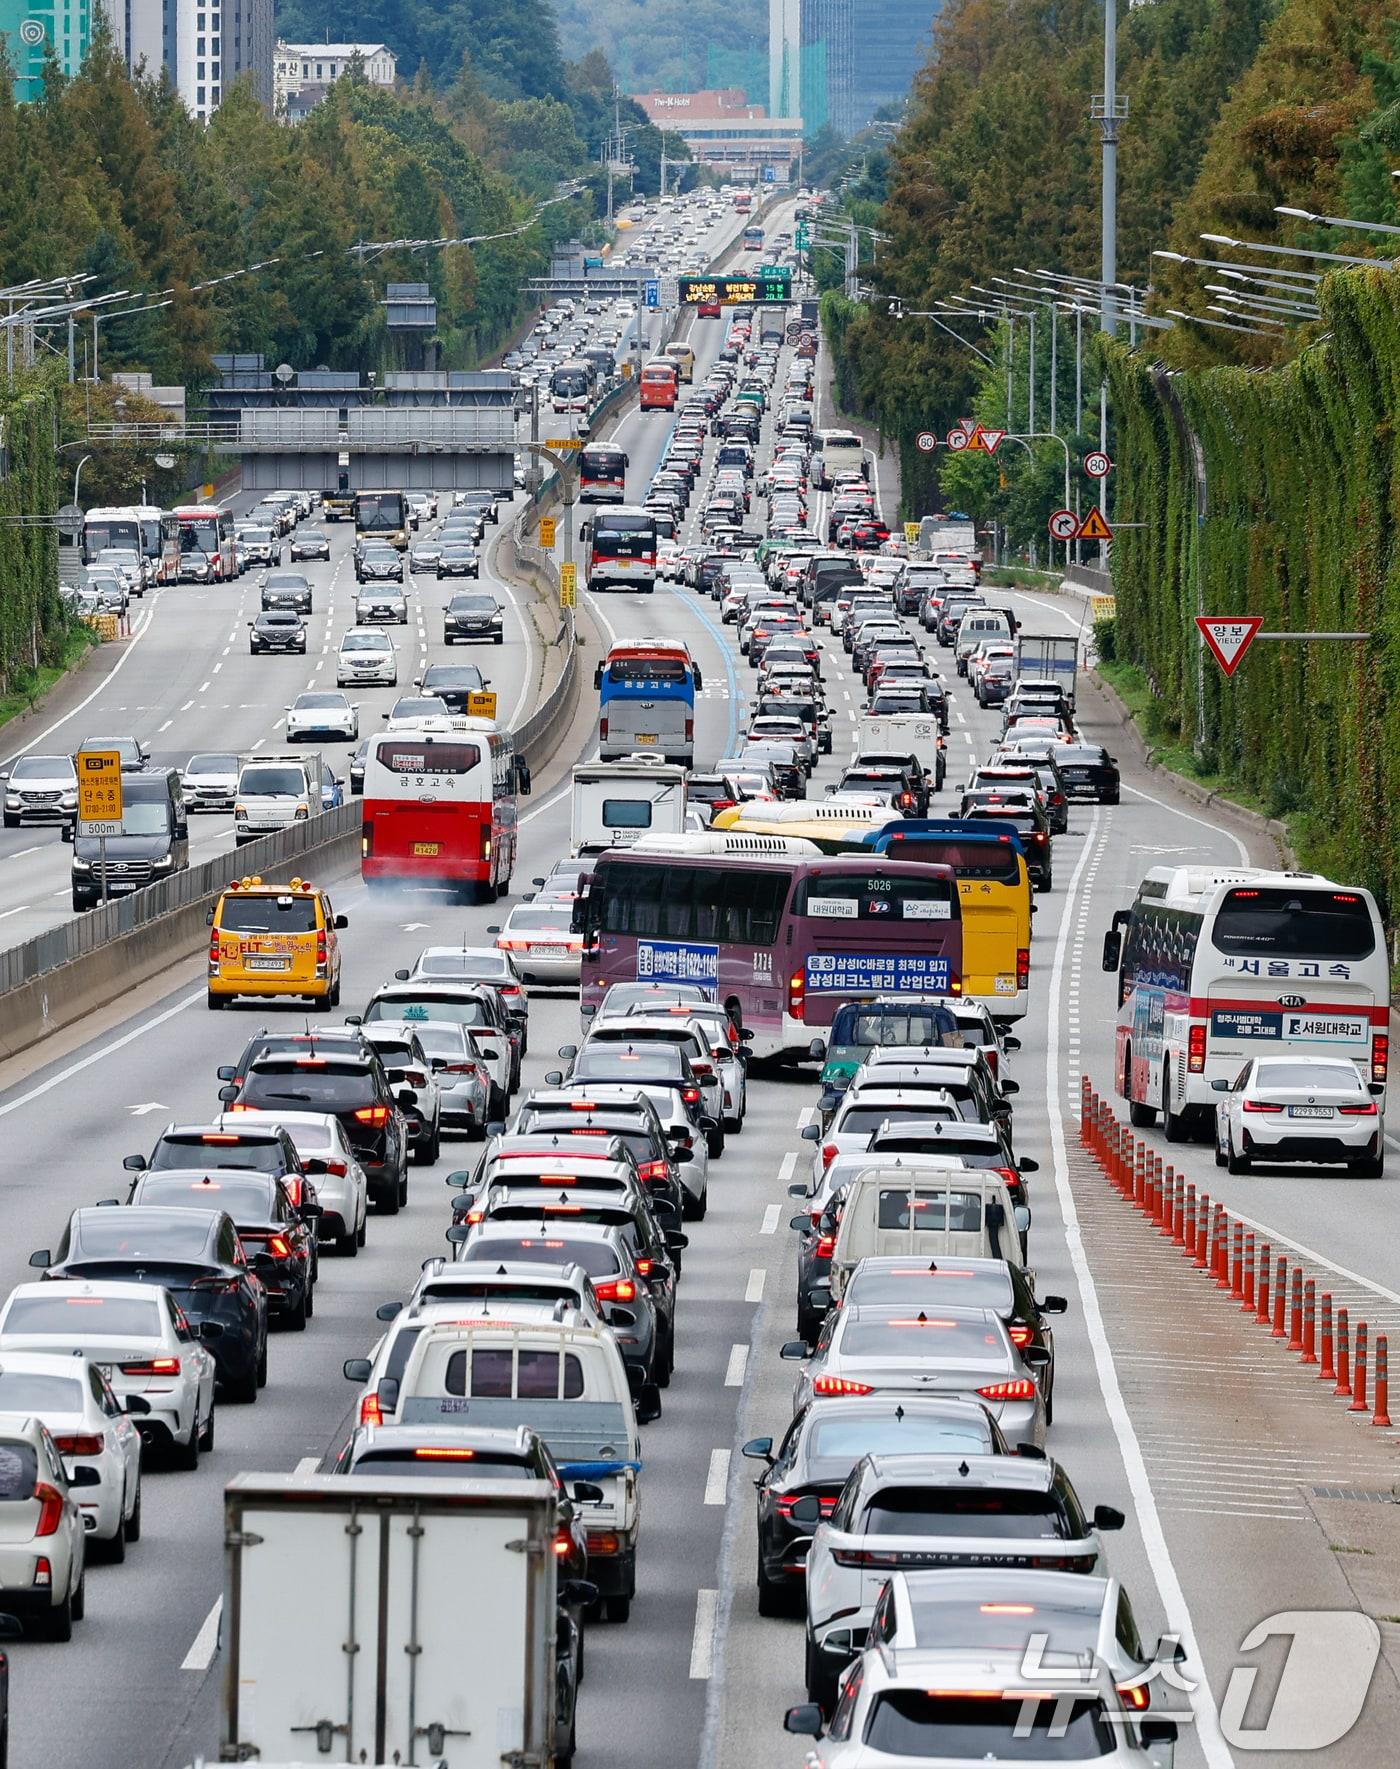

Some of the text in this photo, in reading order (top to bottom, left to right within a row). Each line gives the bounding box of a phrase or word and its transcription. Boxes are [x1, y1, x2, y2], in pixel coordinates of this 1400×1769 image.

[1090, 459, 1105, 471] 80
[1213, 626, 1244, 637] 양보
[400, 776, 456, 789] 금호고속
[84, 790, 115, 802] 단속중
[88, 823, 115, 835] 500m
[867, 880, 891, 891] 5026
[813, 904, 853, 915] 대원대학교
[639, 949, 652, 972] 음성
[809, 956, 947, 972] 음성 삼성IC바로옆 최적의 입지
[899, 975, 947, 989] 산업단지
[1281, 996, 1302, 1006] KIA
[1302, 1021, 1362, 1036] 서원대학교
[902, 1552, 1027, 1563] RANGE ROVER
